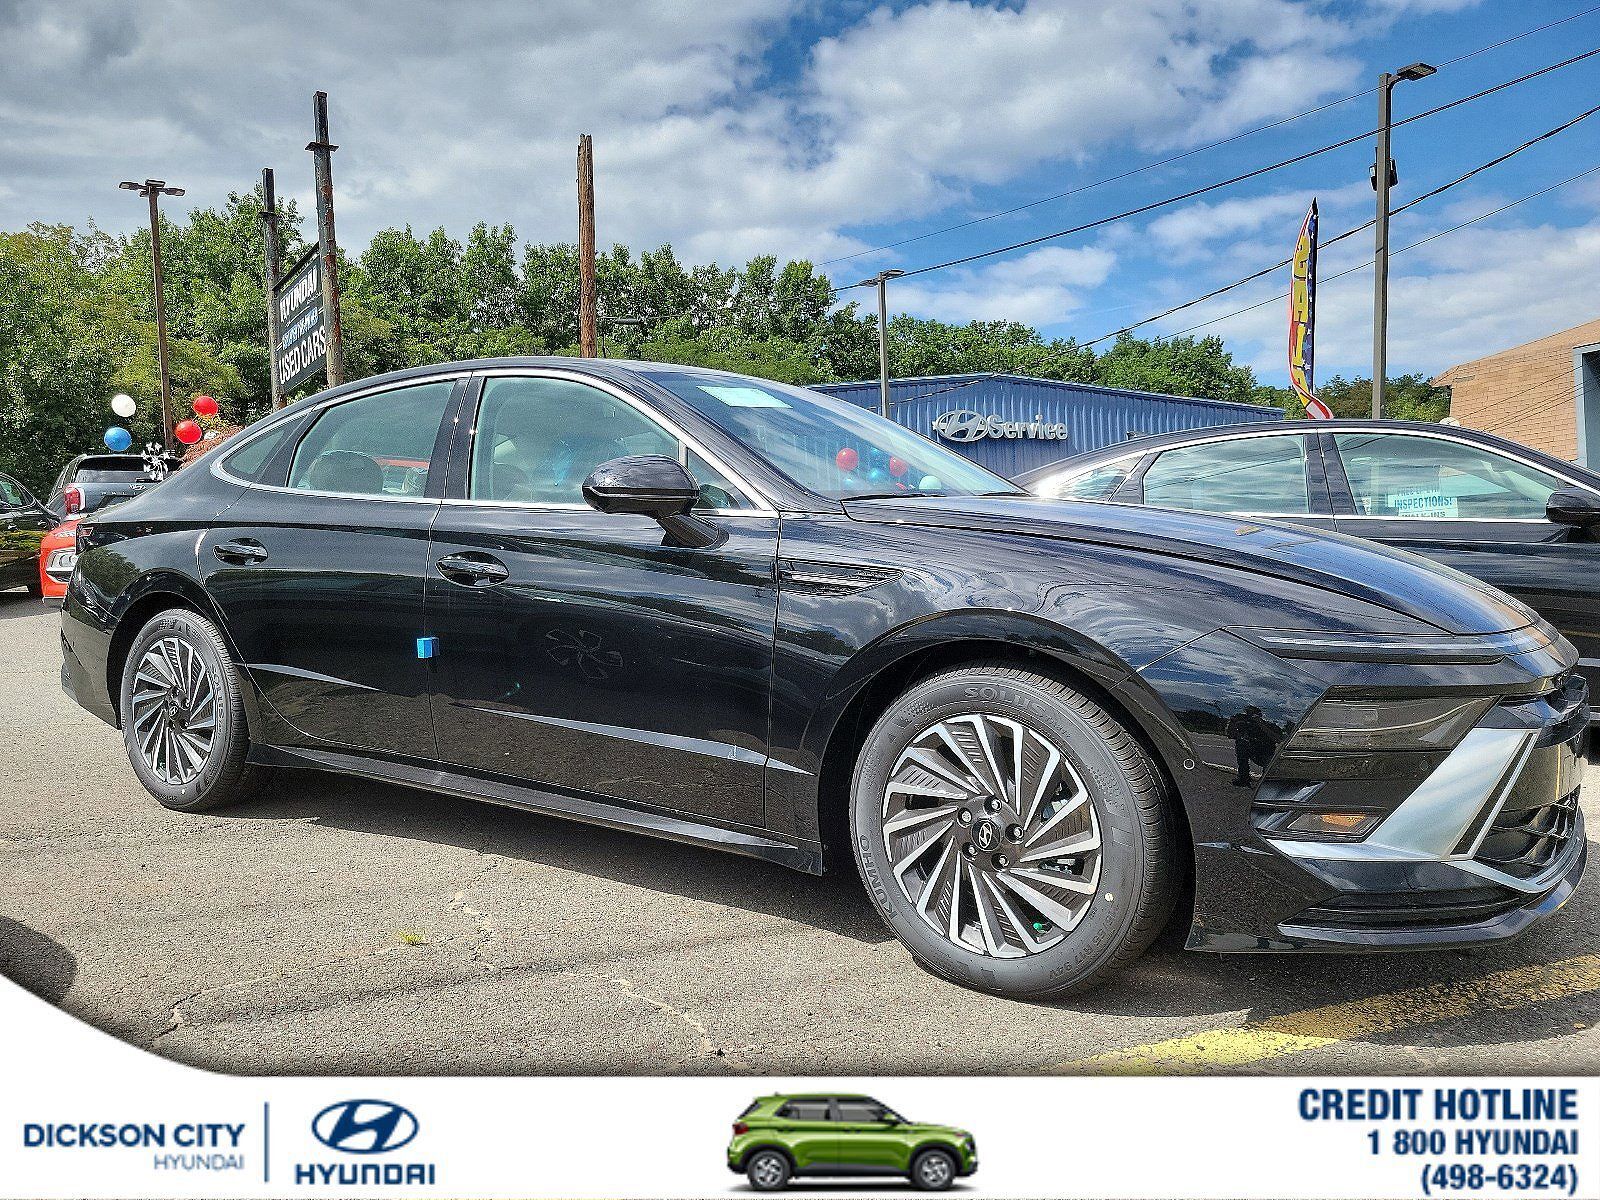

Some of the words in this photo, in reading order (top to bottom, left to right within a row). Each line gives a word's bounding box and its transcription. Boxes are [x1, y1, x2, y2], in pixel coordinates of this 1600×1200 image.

[279, 346, 301, 385] USED
[301, 325, 327, 369] CARS
[986, 414, 1068, 440] Service
[1394, 495, 1453, 510] INSPECTIONS!
[860, 834, 898, 920] KUMHO
